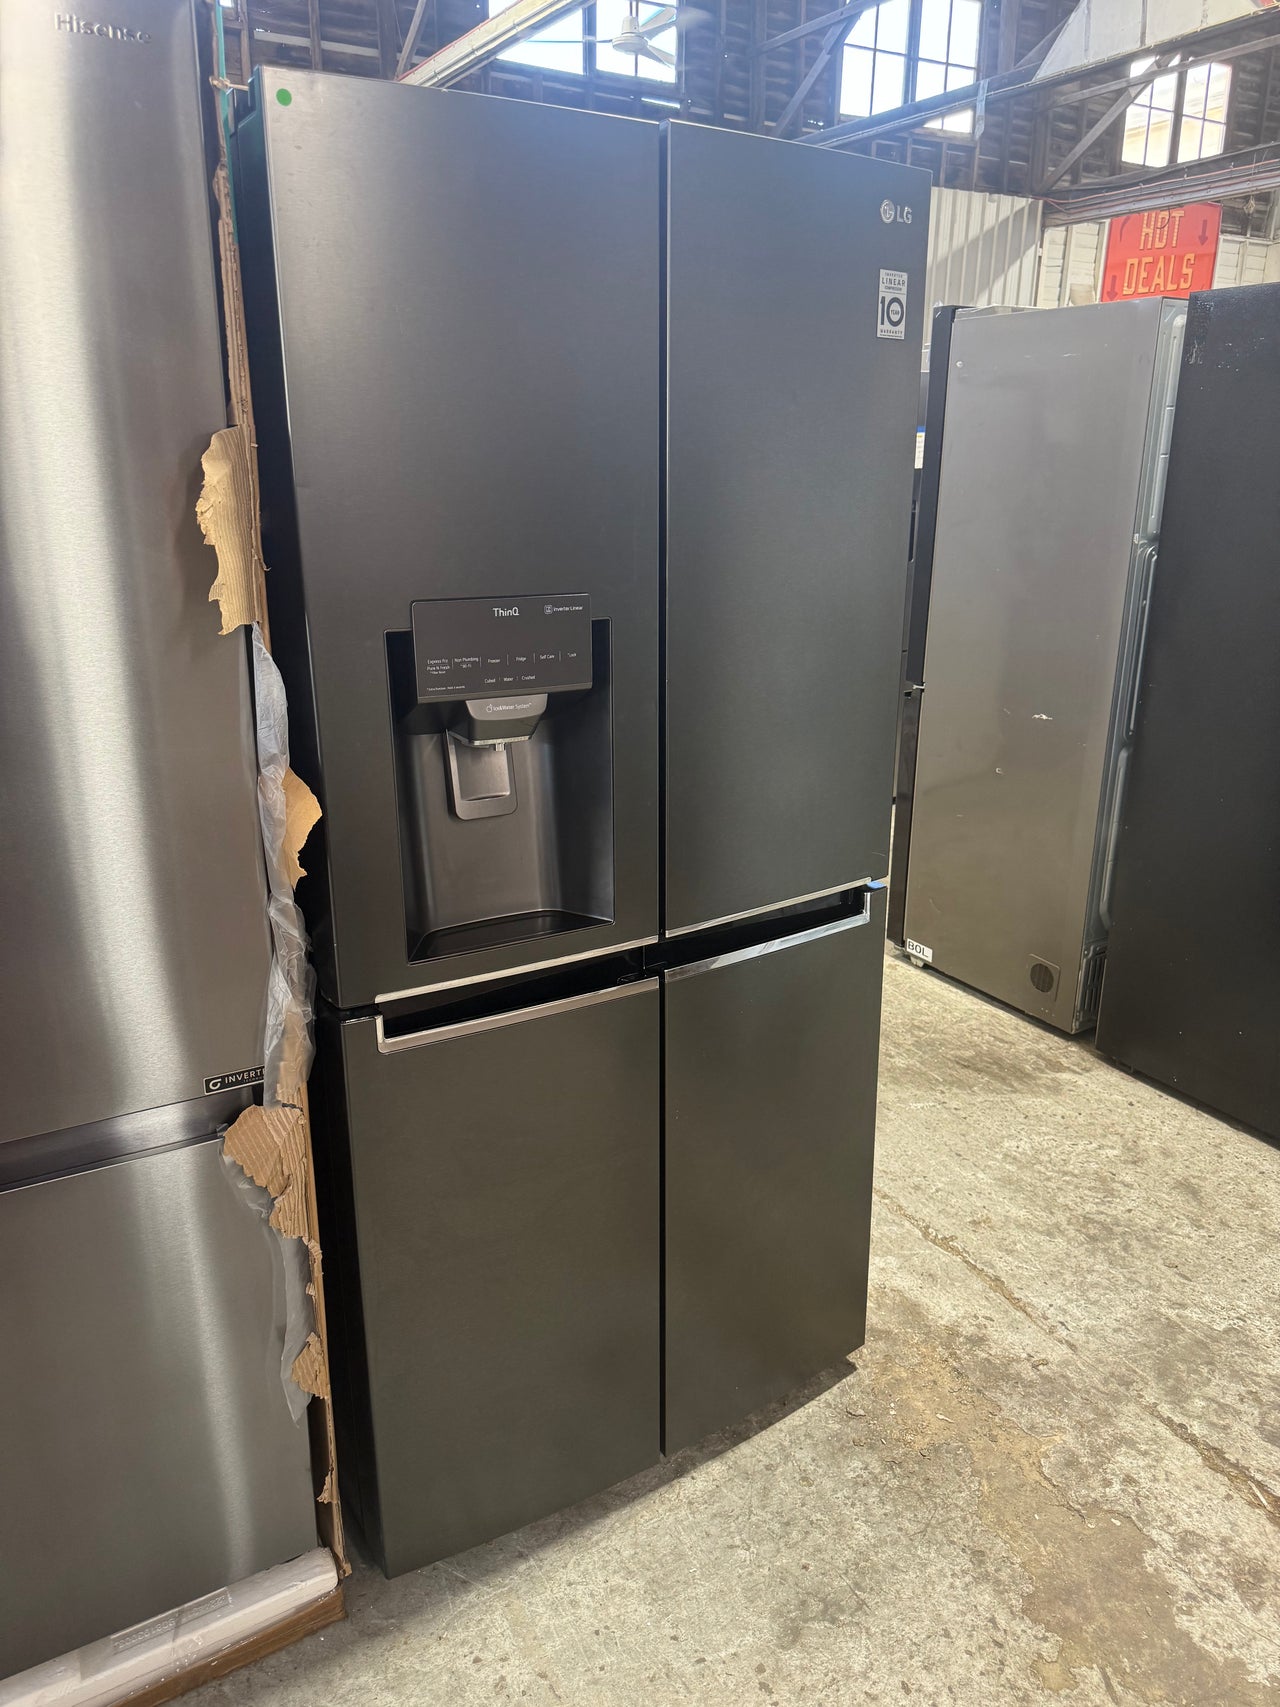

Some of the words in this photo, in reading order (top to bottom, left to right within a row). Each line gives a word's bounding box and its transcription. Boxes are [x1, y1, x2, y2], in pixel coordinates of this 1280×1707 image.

[54, 12, 152, 43] Hisense
[896, 205, 913, 224] LG
[881, 277, 906, 287] LINEAR
[1122, 253, 1195, 296] DEALS
[880, 296, 905, 327] 10
[492, 606, 520, 617] ThinQ
